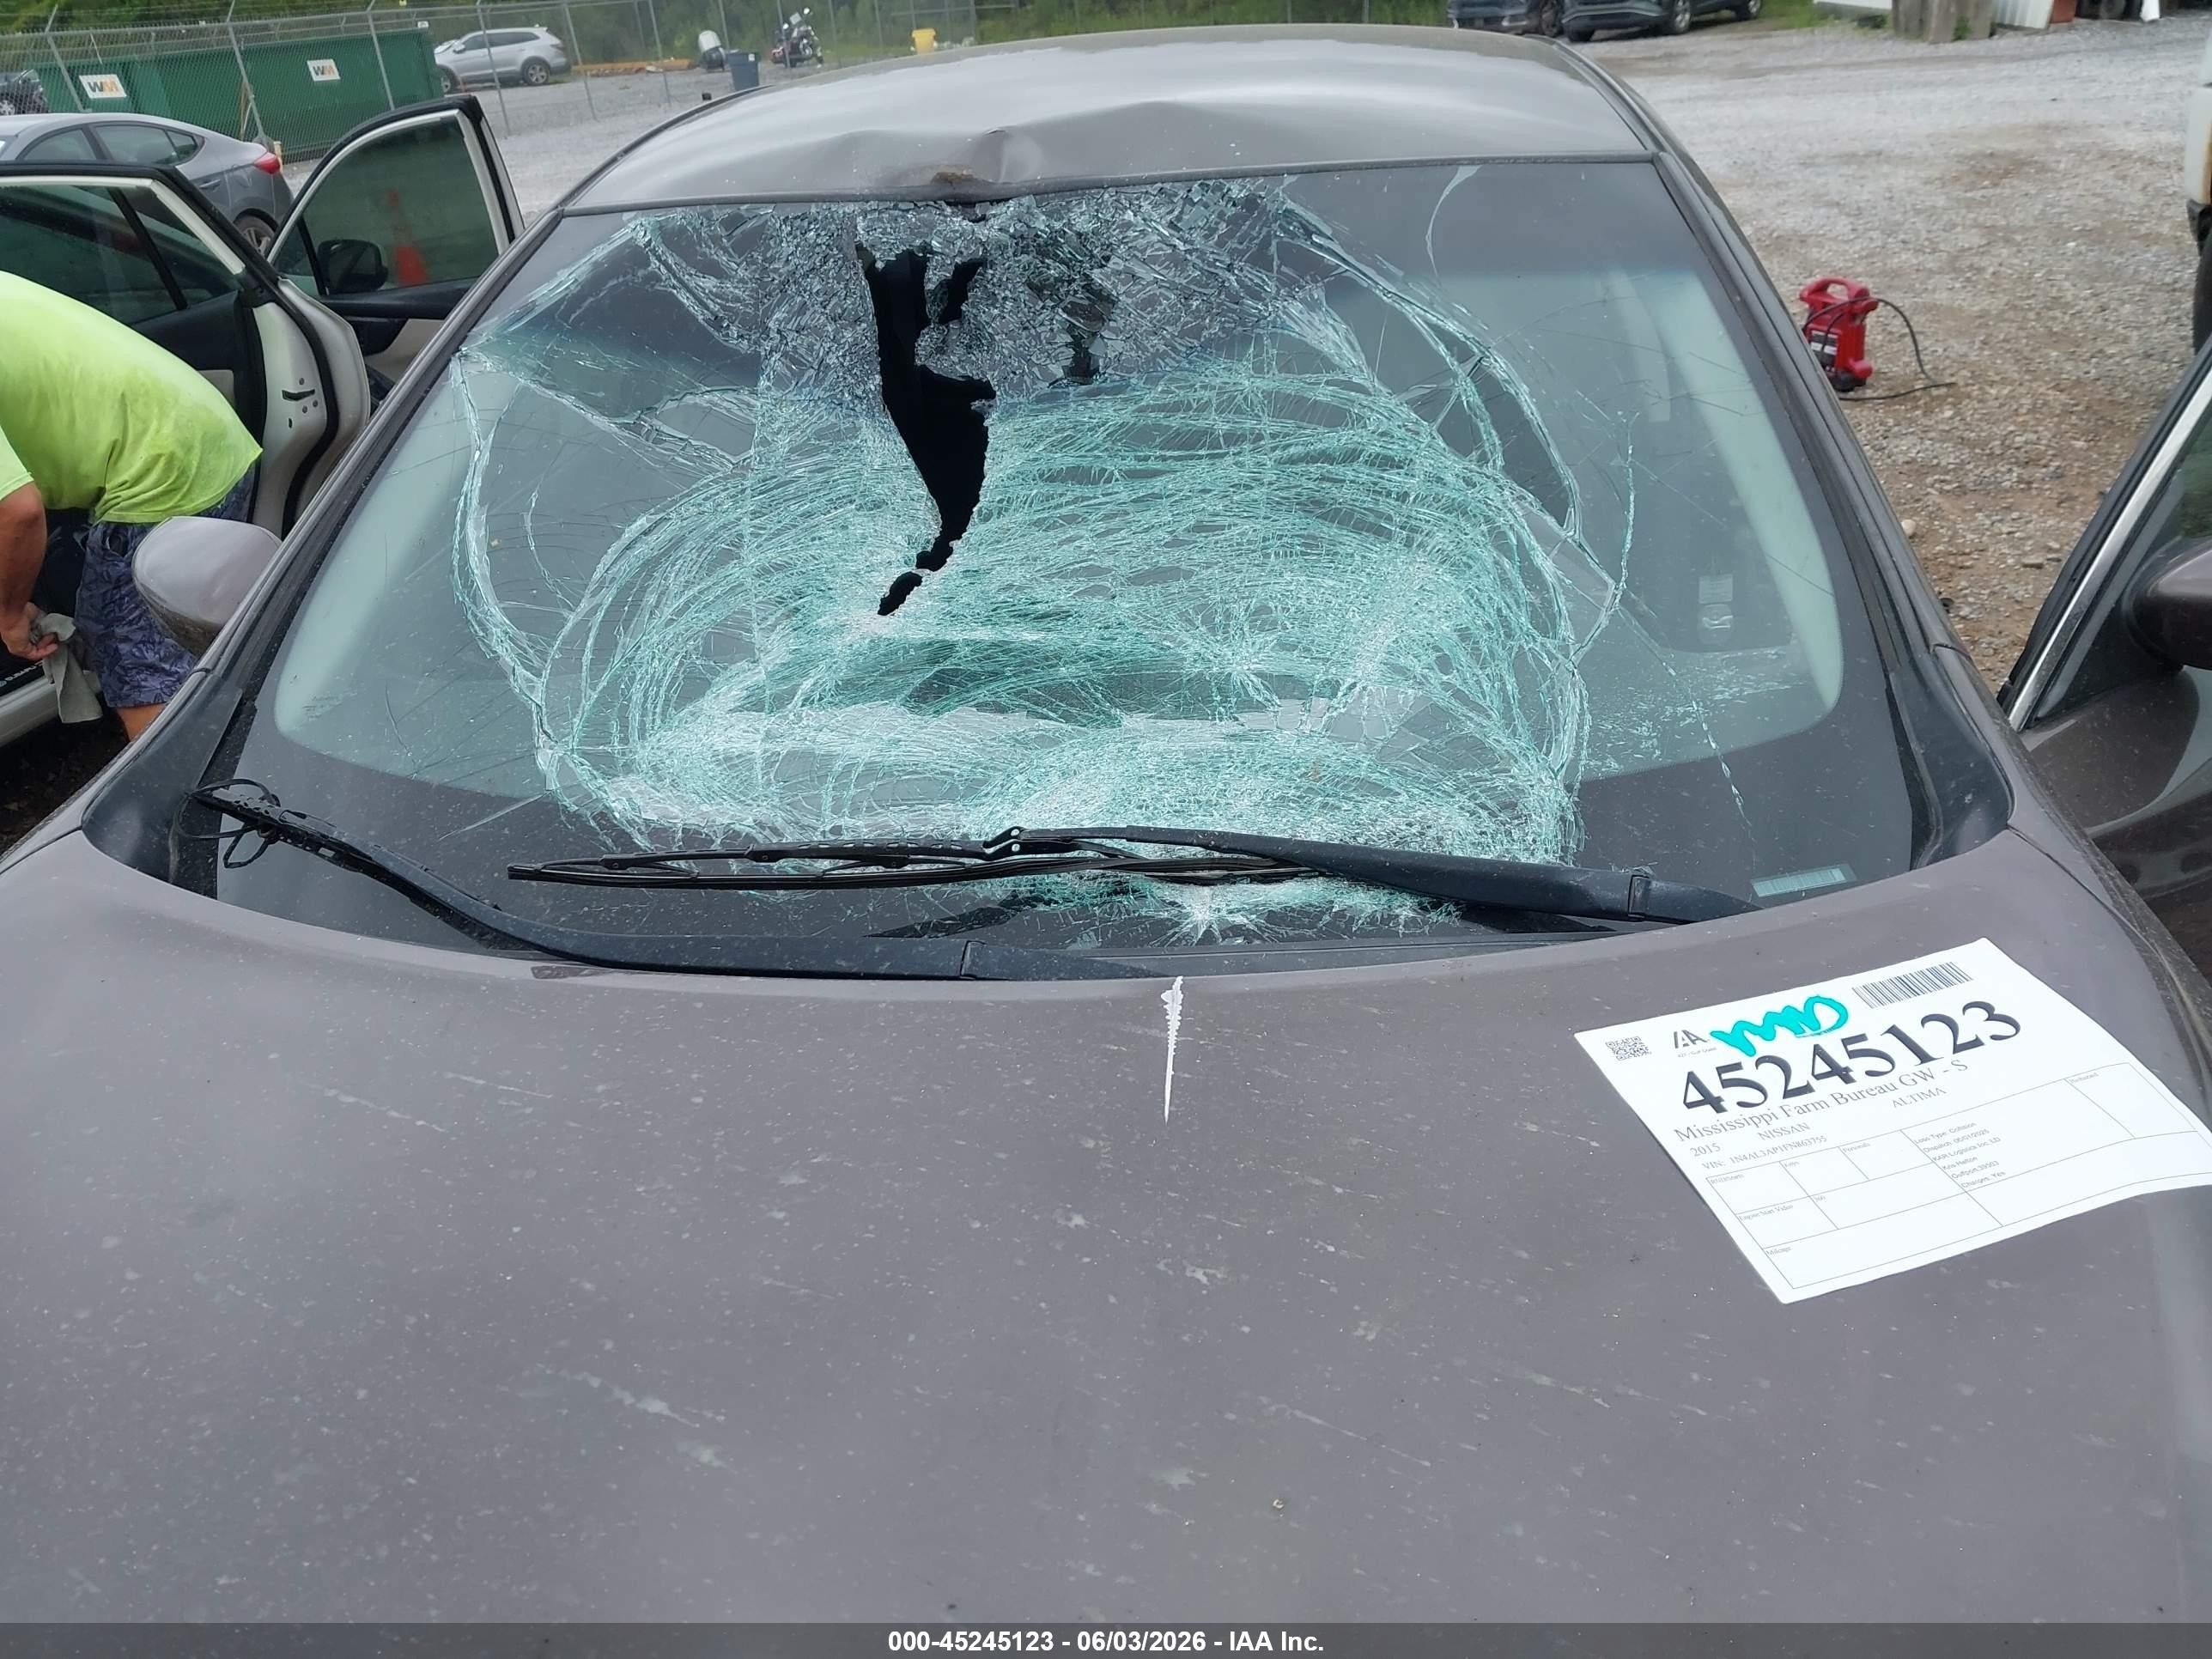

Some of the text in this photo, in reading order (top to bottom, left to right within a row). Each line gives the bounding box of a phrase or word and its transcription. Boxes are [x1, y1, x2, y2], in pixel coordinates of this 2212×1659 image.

[1683, 1001, 2021, 1114] 45245123
[1674, 1108, 1778, 1141] Mississippi
[1779, 1099, 1830, 1118] Farm
[1830, 1082, 1899, 1105] Bureau
[1899, 1067, 1937, 1086] GW
[1951, 1060, 1968, 1072] S
[1689, 1087, 1948, 1157] 2015 NISSAN ALTIMA
[1702, 1158, 1725, 1170] VIN:
